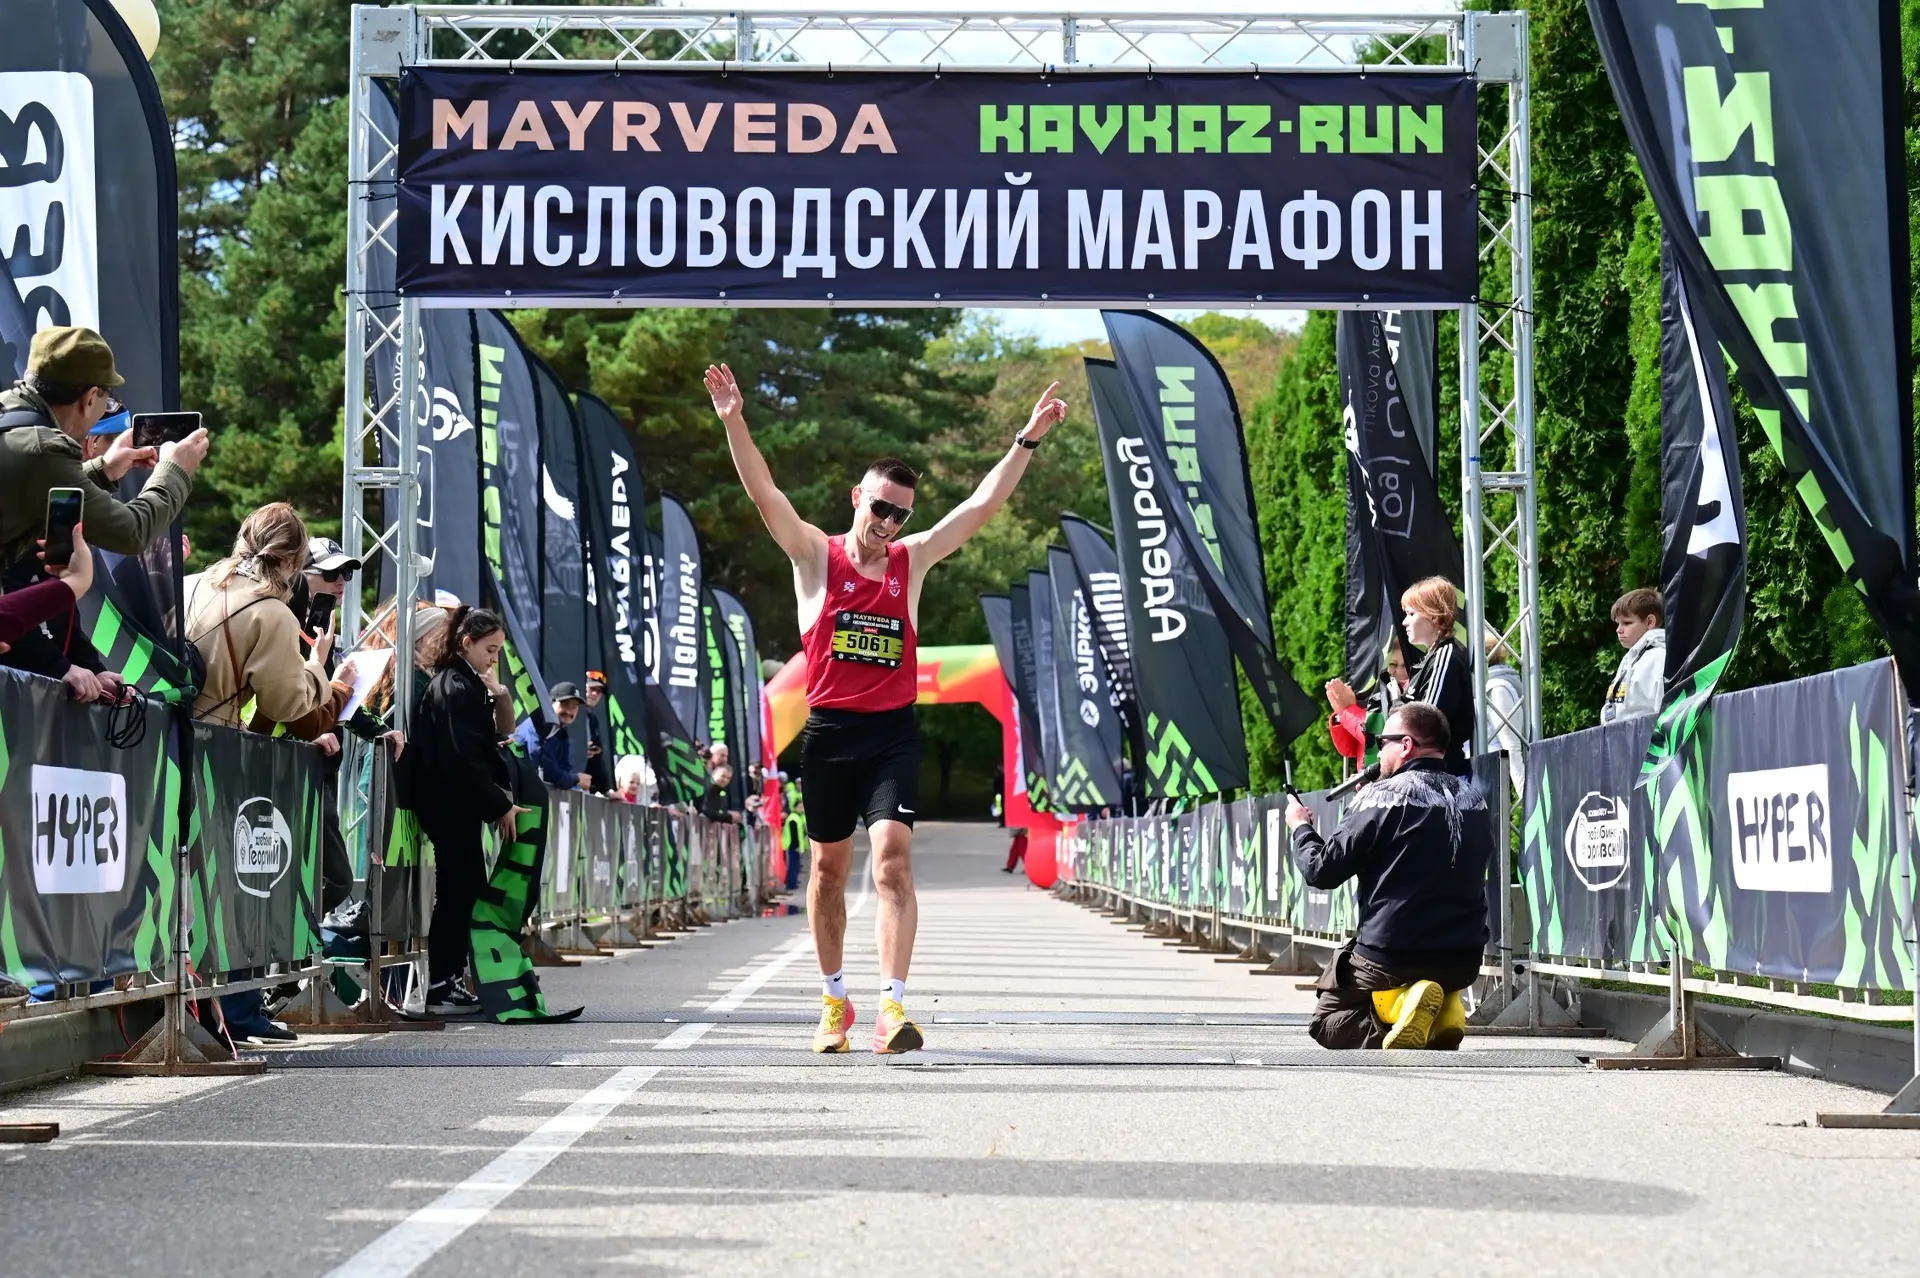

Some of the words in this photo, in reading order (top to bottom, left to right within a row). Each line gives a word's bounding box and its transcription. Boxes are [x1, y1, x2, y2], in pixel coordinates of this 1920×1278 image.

[432, 99, 898, 154] MAYRVEDA
[430, 171, 1040, 278] КИСЛОВОДСКИЙ
[1067, 188, 1443, 271] МАРАФОН
[846, 634, 889, 653] 5061
[853, 613, 890, 623] MAYRVEDA
[35, 791, 119, 867] HYPER
